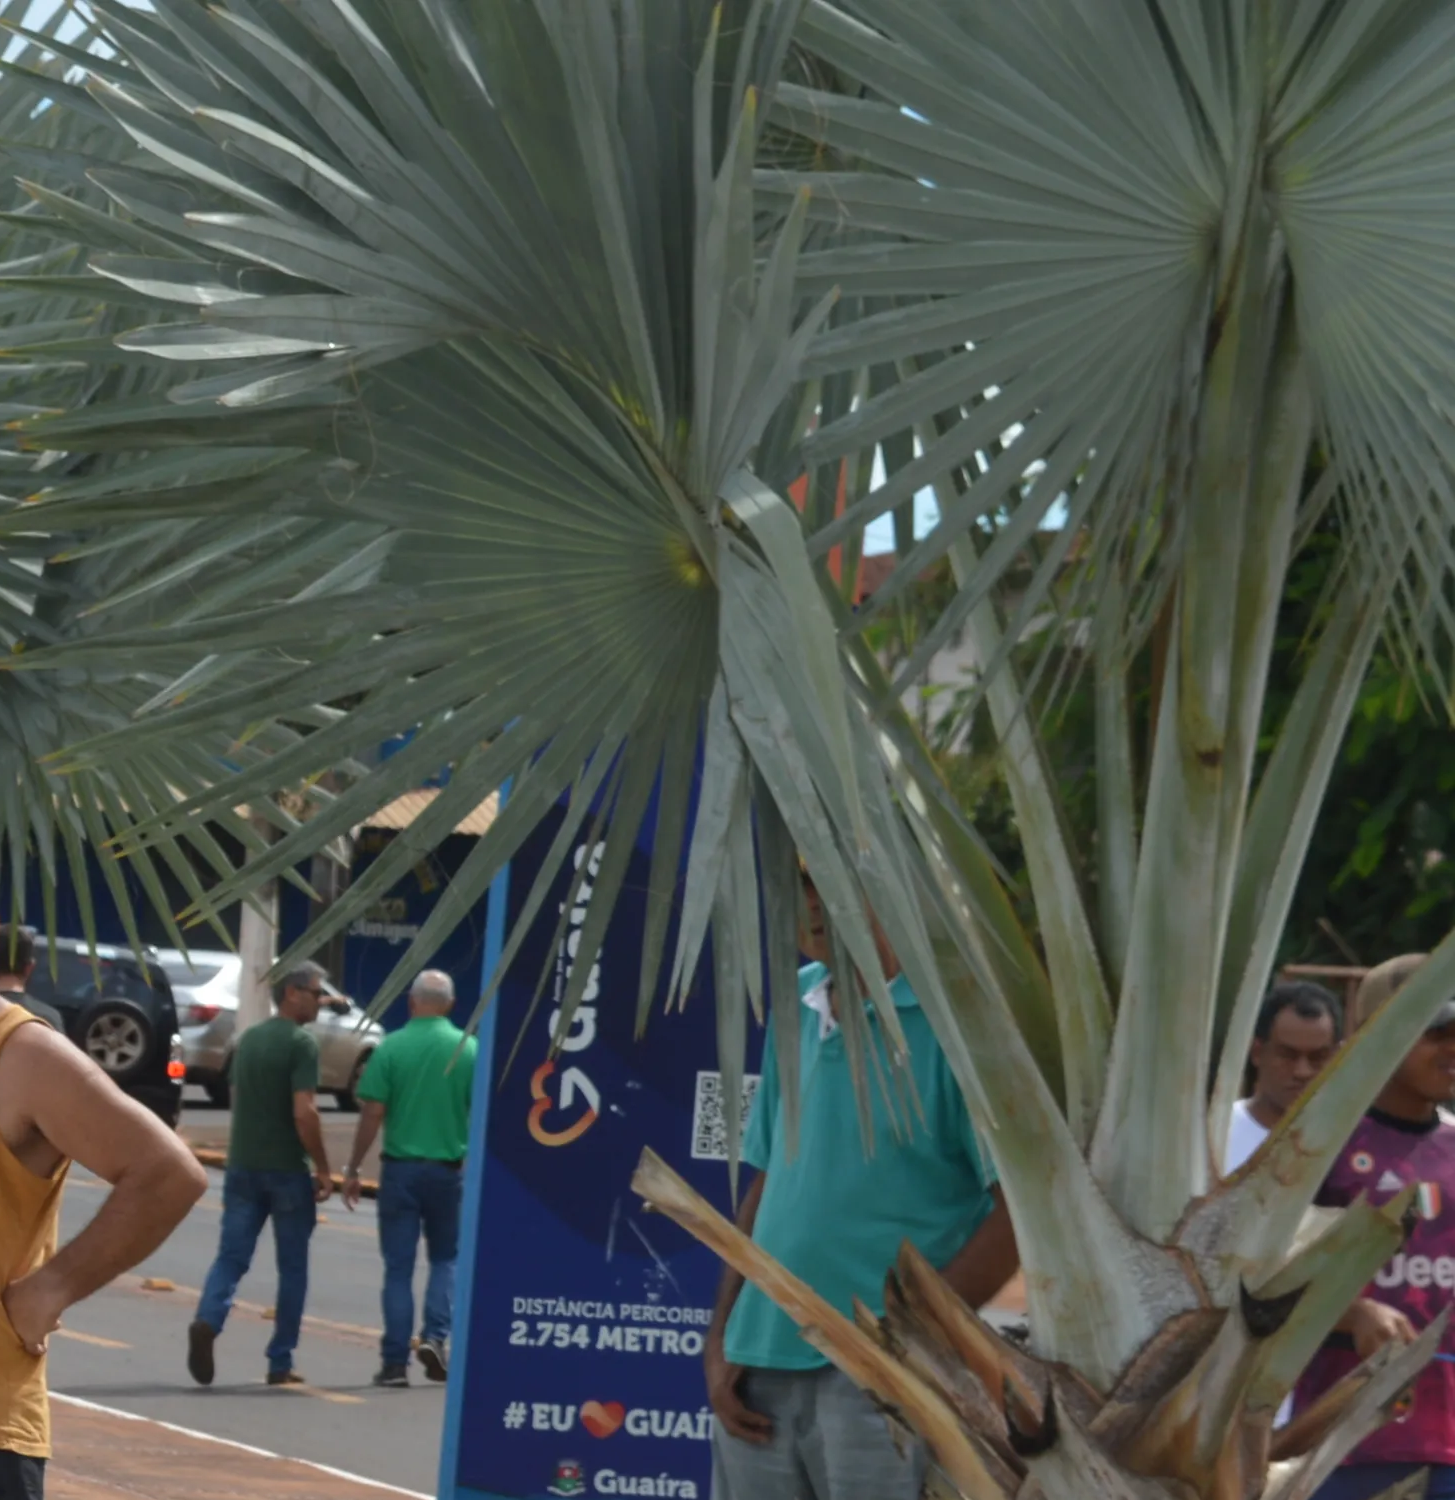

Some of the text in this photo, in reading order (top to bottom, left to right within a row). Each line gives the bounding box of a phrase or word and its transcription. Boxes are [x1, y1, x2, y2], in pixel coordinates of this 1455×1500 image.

[1374, 1252, 1455, 1296] Jee
[513, 1296, 615, 1320] DISTÂNCIA
[509, 1320, 590, 1349] 2.754
[593, 1468, 698, 1499] Guaíra
